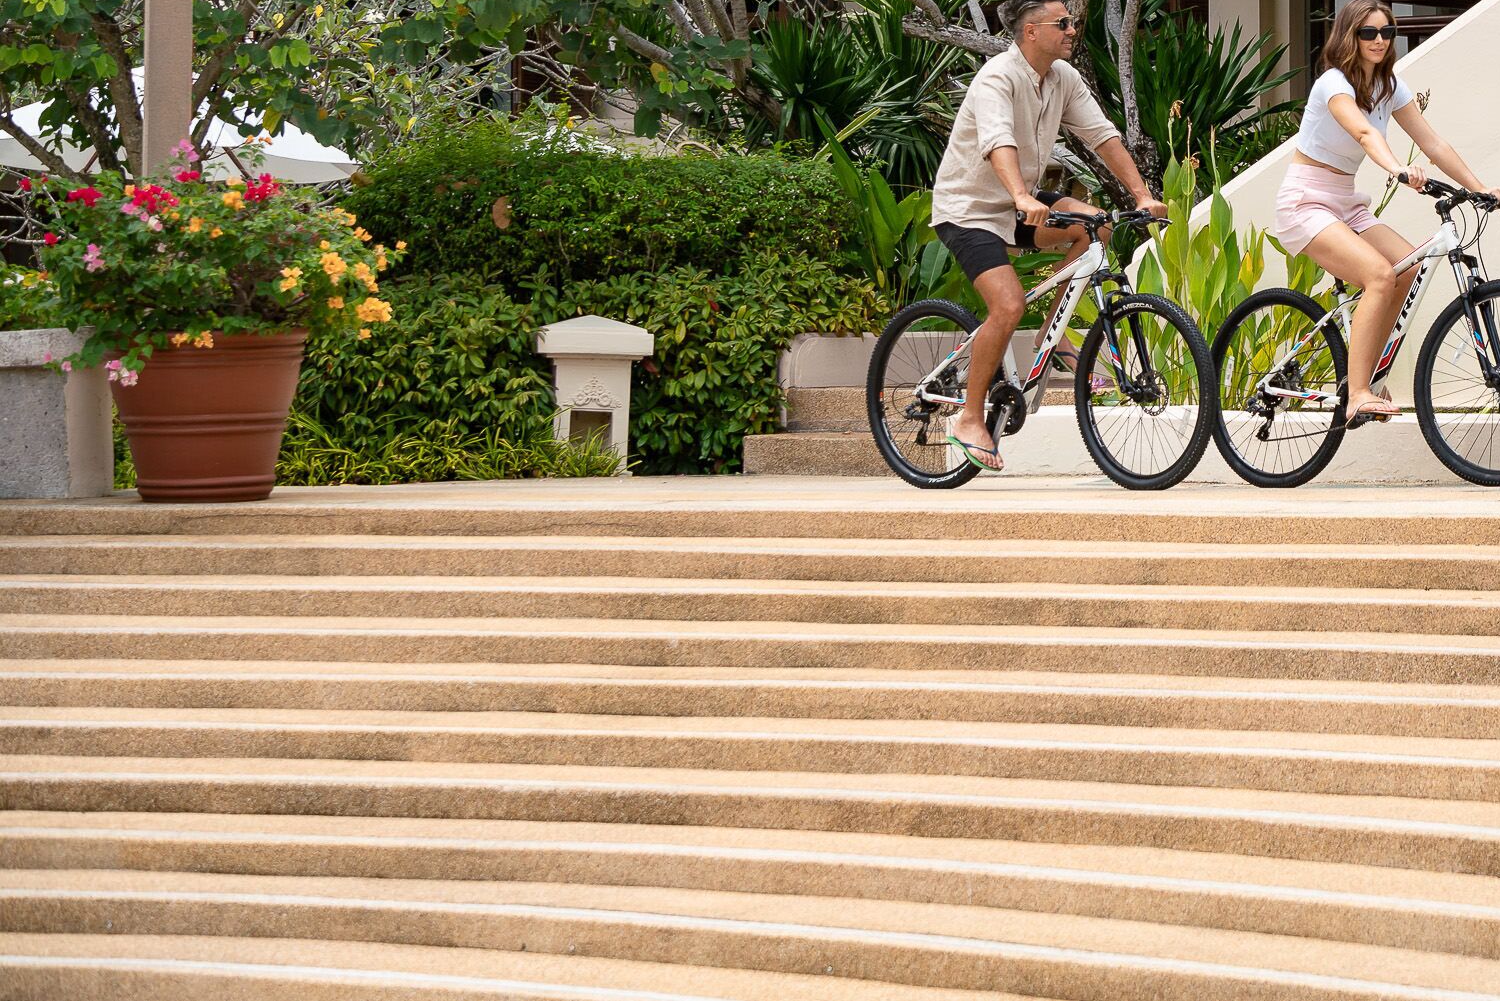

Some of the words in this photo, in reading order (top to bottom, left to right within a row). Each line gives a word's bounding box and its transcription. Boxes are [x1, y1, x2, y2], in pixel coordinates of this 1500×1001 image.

[1044, 282, 1076, 343] TREK
[1122, 302, 1155, 312] MEZCAL
[1391, 263, 1428, 334] TREK
